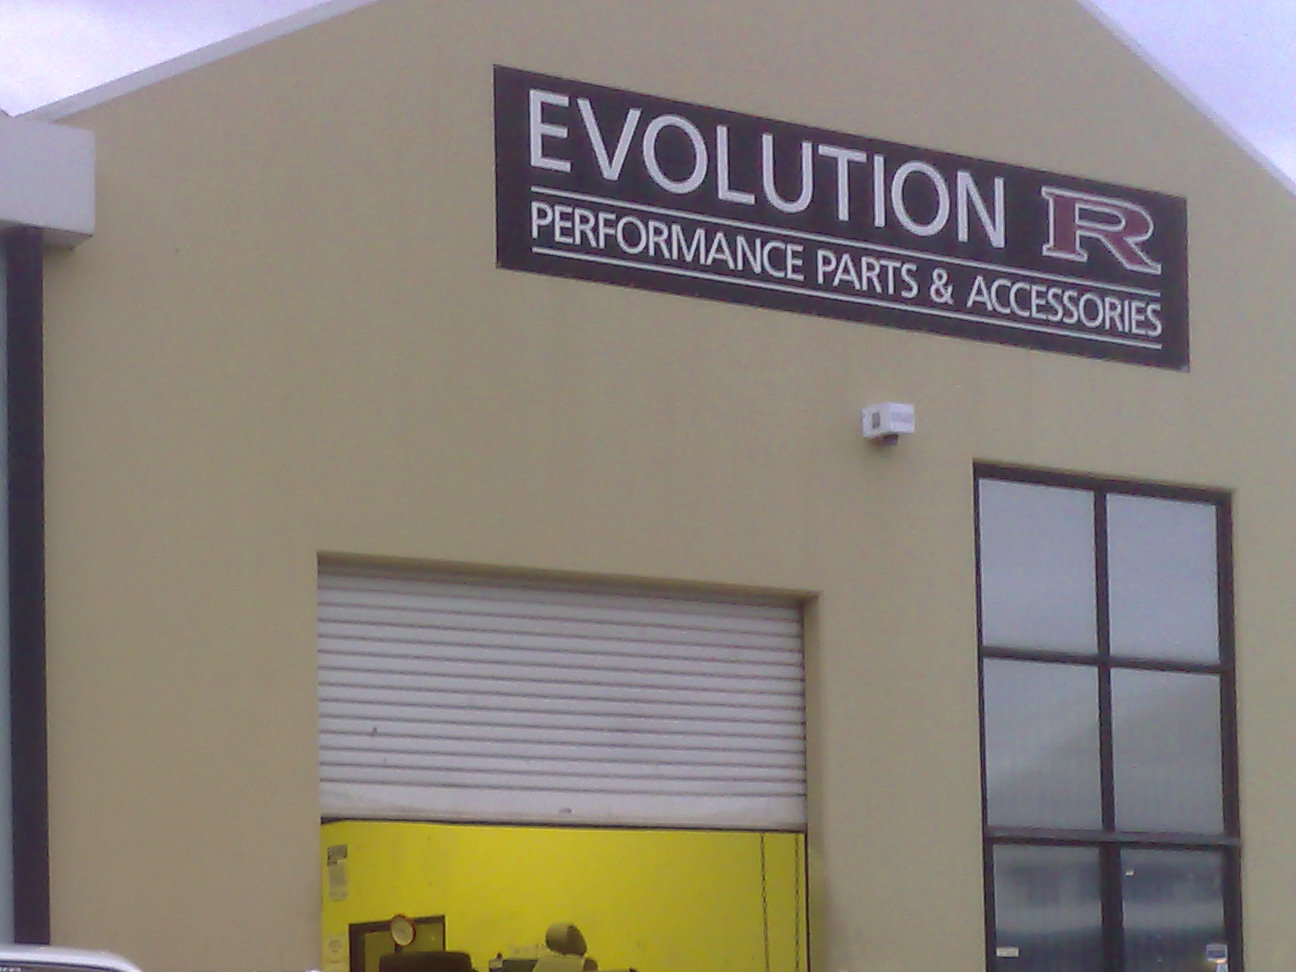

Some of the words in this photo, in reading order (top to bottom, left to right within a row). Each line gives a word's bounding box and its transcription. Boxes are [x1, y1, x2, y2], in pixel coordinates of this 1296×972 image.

[529, 89, 1005, 249] EVOLUTION
[1041, 186, 1162, 275] R
[531, 202, 805, 280] PERFORMANCE
[816, 251, 919, 300] PARTS
[930, 271, 953, 306] &
[967, 276, 1163, 338] ACCESSORIES
